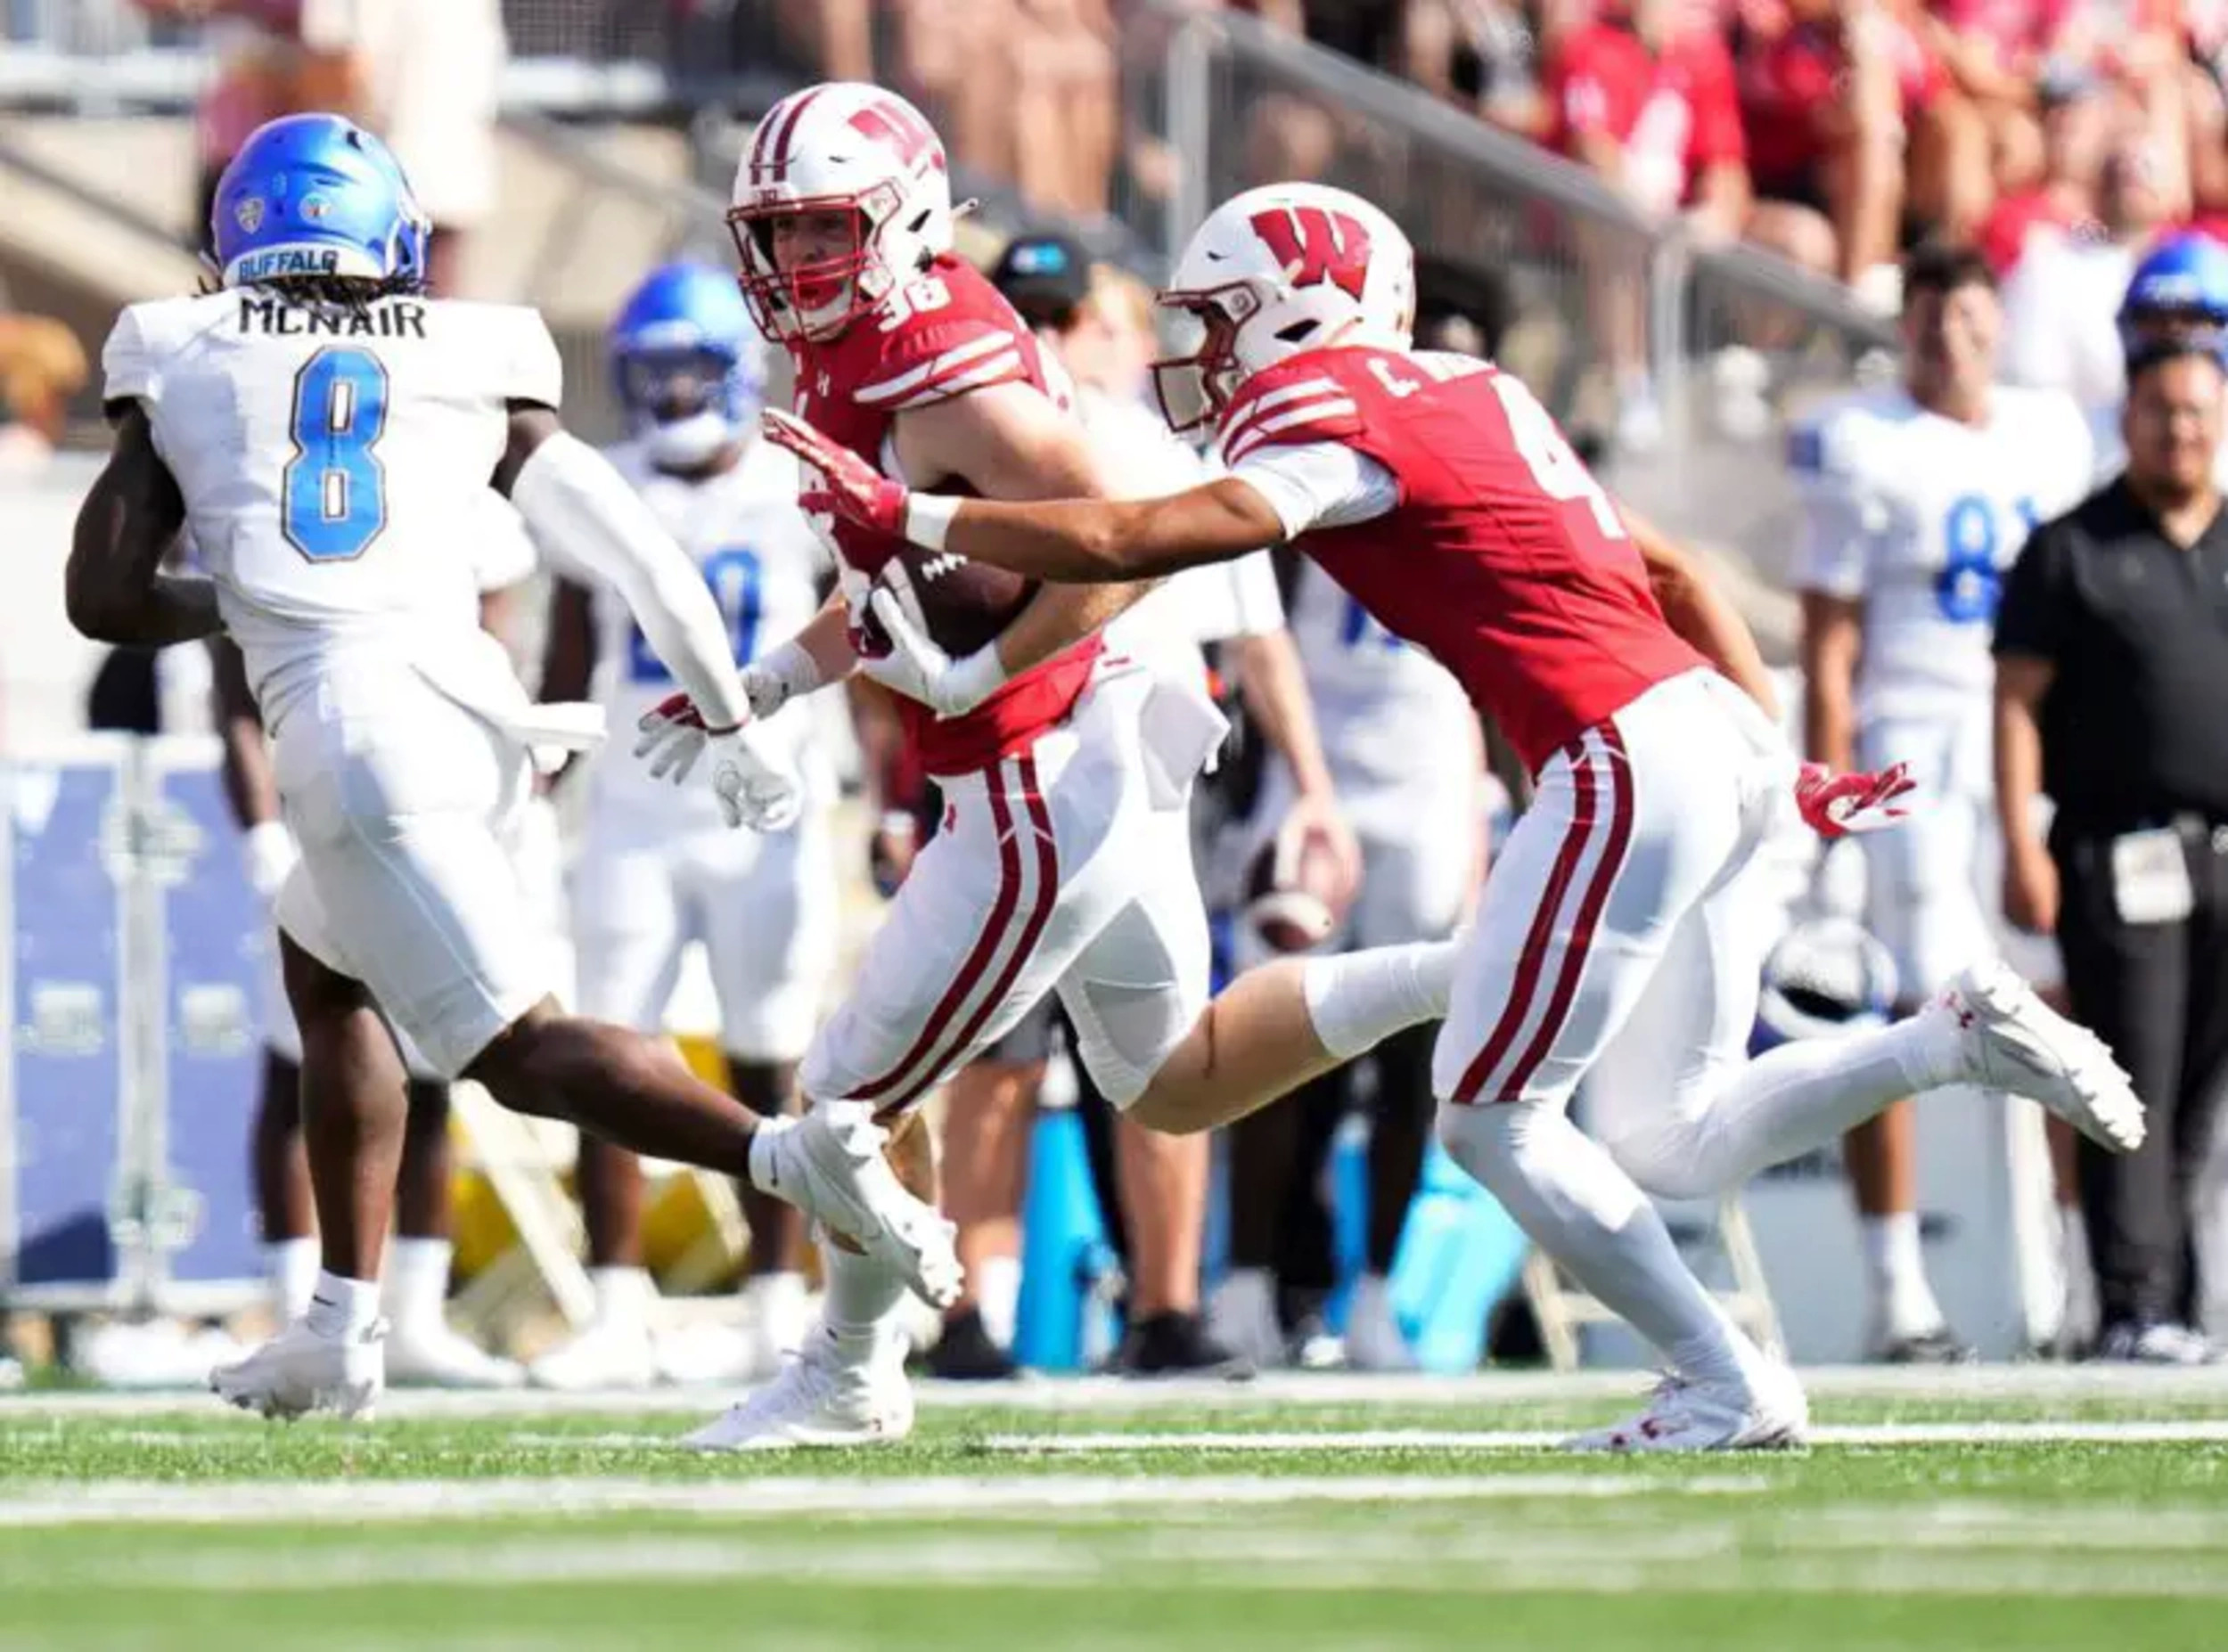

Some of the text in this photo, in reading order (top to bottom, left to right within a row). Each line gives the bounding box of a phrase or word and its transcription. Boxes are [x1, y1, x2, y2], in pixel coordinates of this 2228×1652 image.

[239, 250, 339, 283] BUFFALO
[1249, 206, 1372, 303] W
[240, 298, 426, 338] MCNAIR
[281, 344, 389, 564] 8
[1489, 373, 1627, 538] 4
